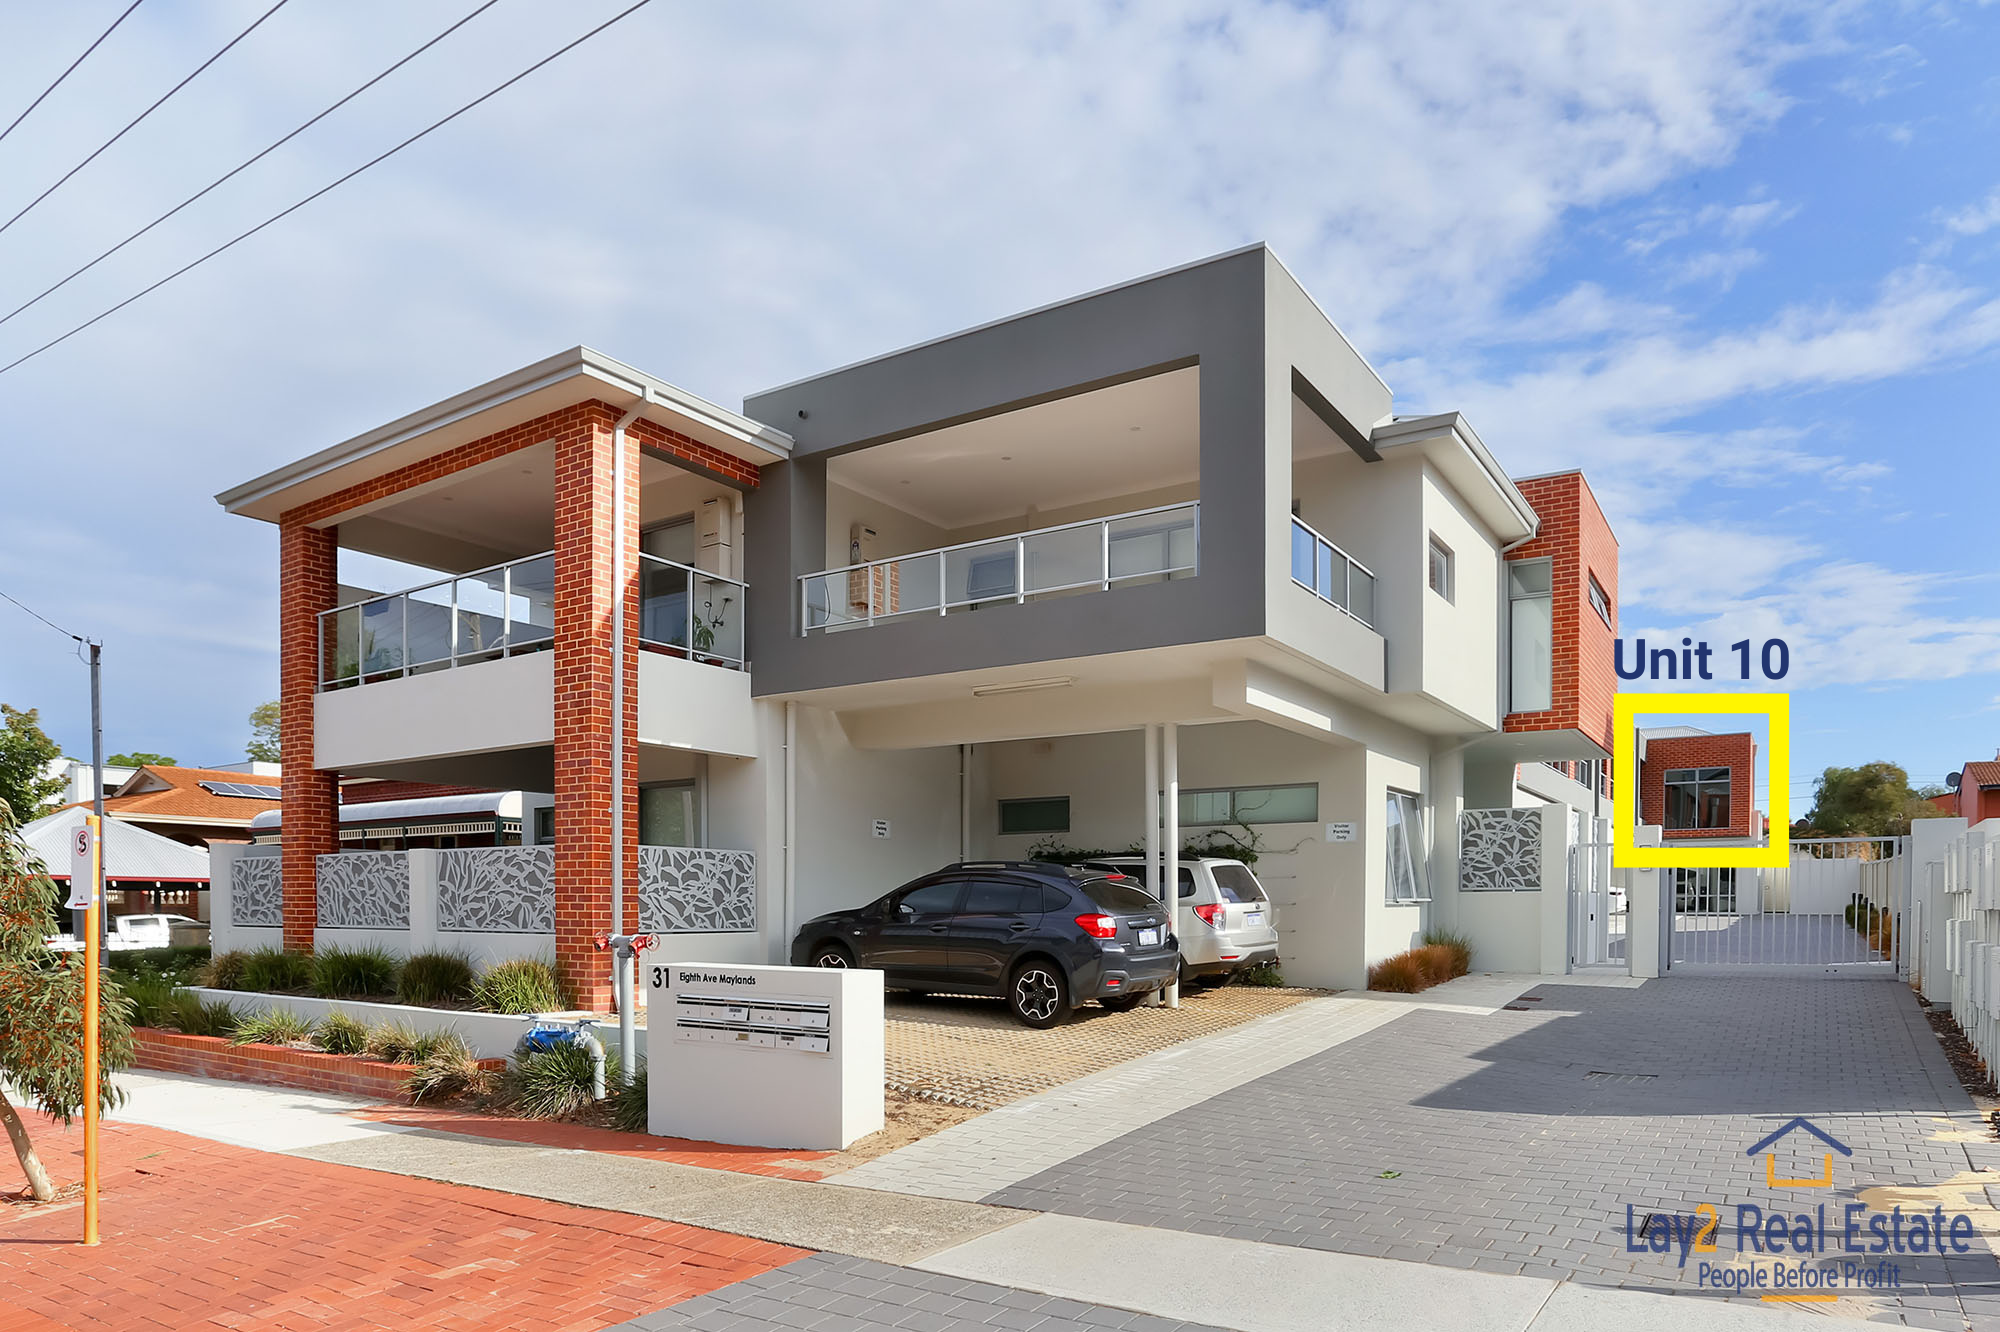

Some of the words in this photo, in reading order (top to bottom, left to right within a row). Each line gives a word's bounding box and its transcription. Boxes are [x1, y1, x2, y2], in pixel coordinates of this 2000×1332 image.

[652, 966, 670, 989] 31
[679, 971, 702, 984] Eighth
[702, 973, 718, 983] Ave
[719, 973, 757, 986] Maylands
